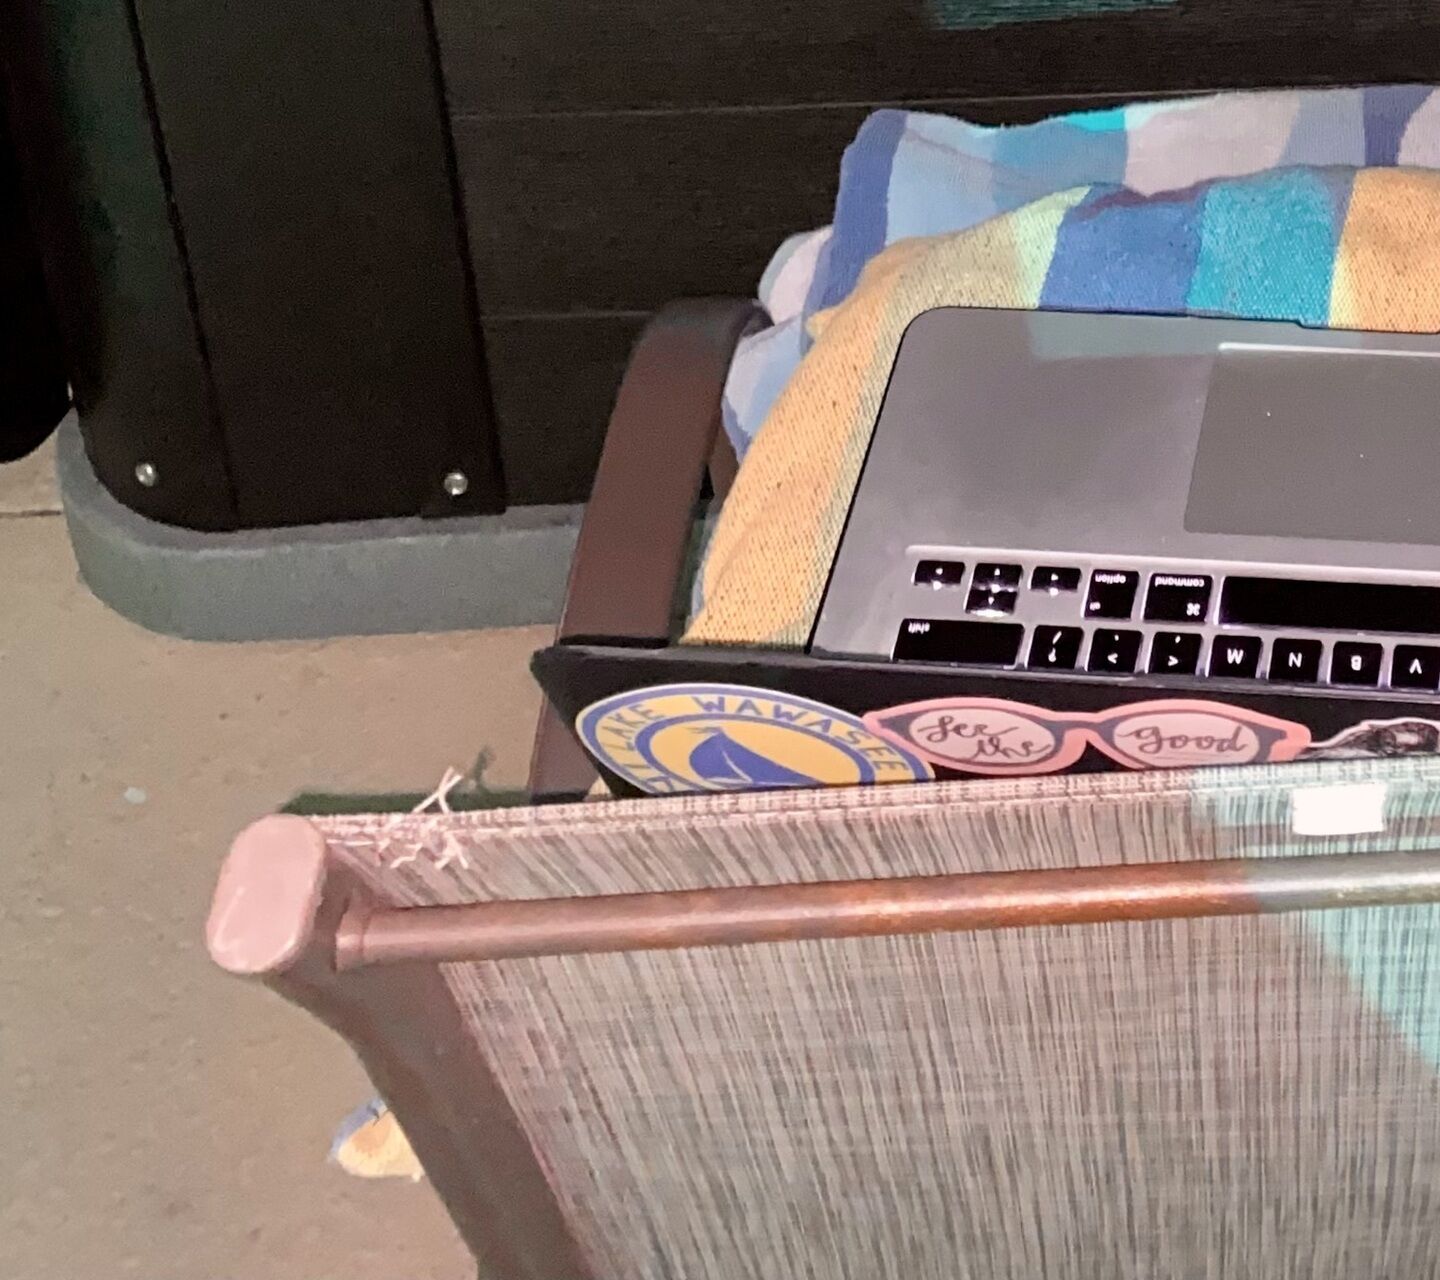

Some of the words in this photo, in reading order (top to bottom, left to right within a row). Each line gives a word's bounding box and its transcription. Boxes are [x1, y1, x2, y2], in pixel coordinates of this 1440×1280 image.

[1095, 574, 1126, 585] option
[1154, 575, 1205, 587] command
[908, 621, 930, 634] shift
[1226, 648, 1244, 665] M
[1288, 652, 1302, 668] N
[1350, 655, 1362, 671] B
[1409, 658, 1423, 675] V
[602, 703, 666, 751] LAKE
[692, 696, 909, 773] WAWASEE
[918, 715, 1019, 741] See
[971, 735, 1052, 762] the
[1117, 725, 1250, 755] good
